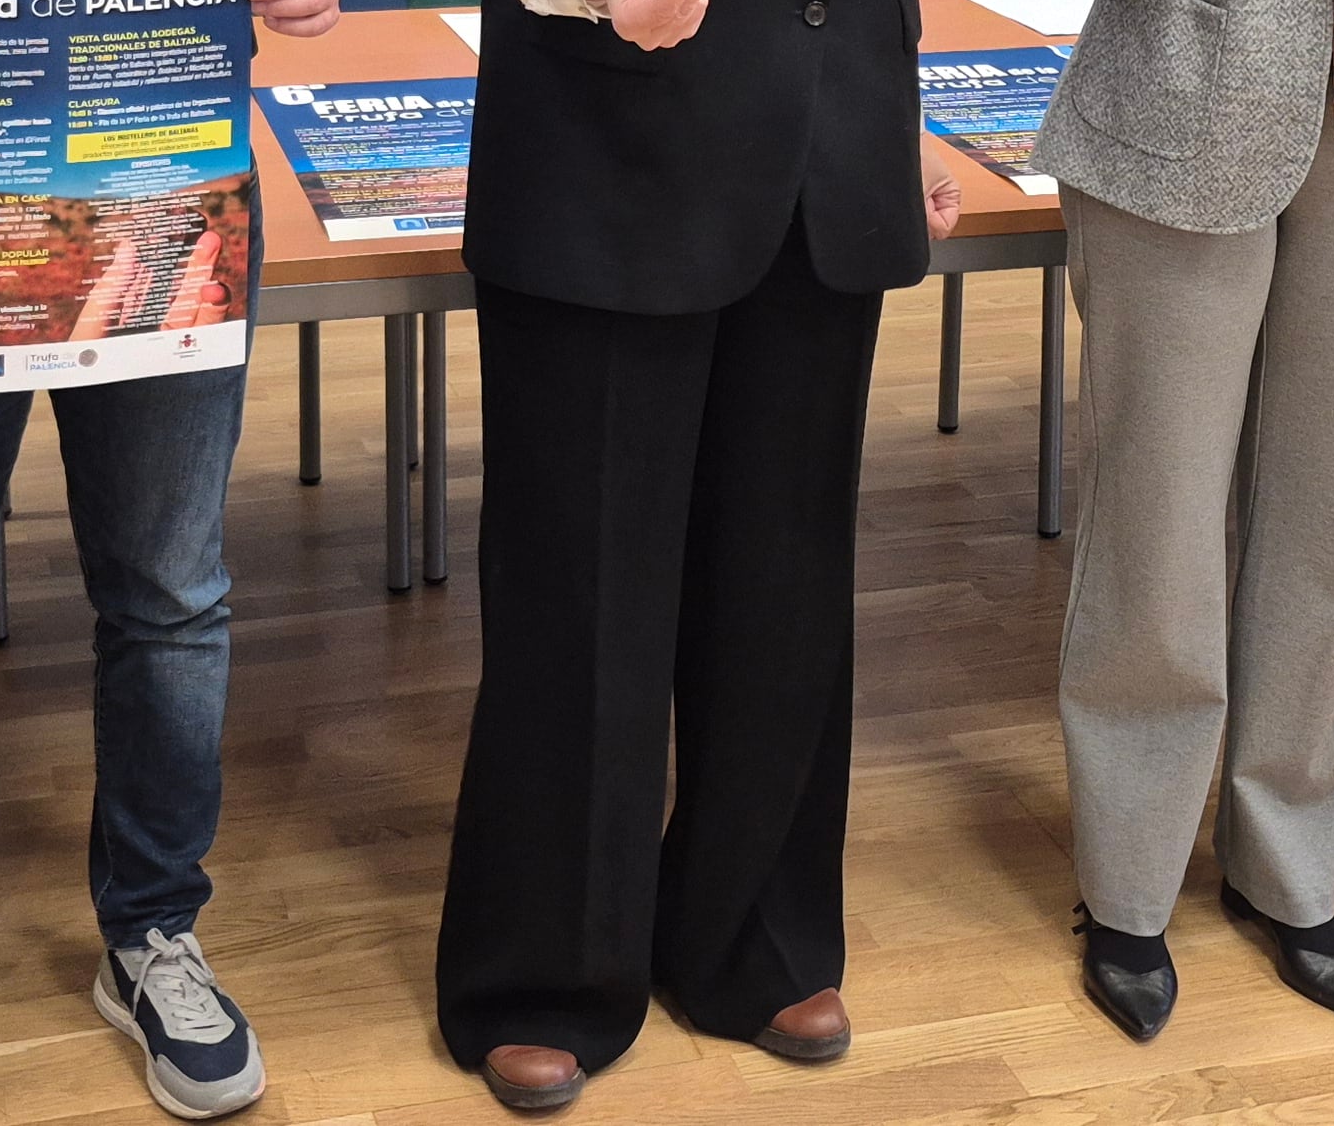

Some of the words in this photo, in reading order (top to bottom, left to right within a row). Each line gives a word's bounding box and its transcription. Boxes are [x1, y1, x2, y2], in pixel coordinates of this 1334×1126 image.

[311, 95, 434, 115] FERIA
[319, 111, 424, 124] Trufa
[30, 353, 59, 363] Trufa
[30, 361, 77, 371] PALENCIA
